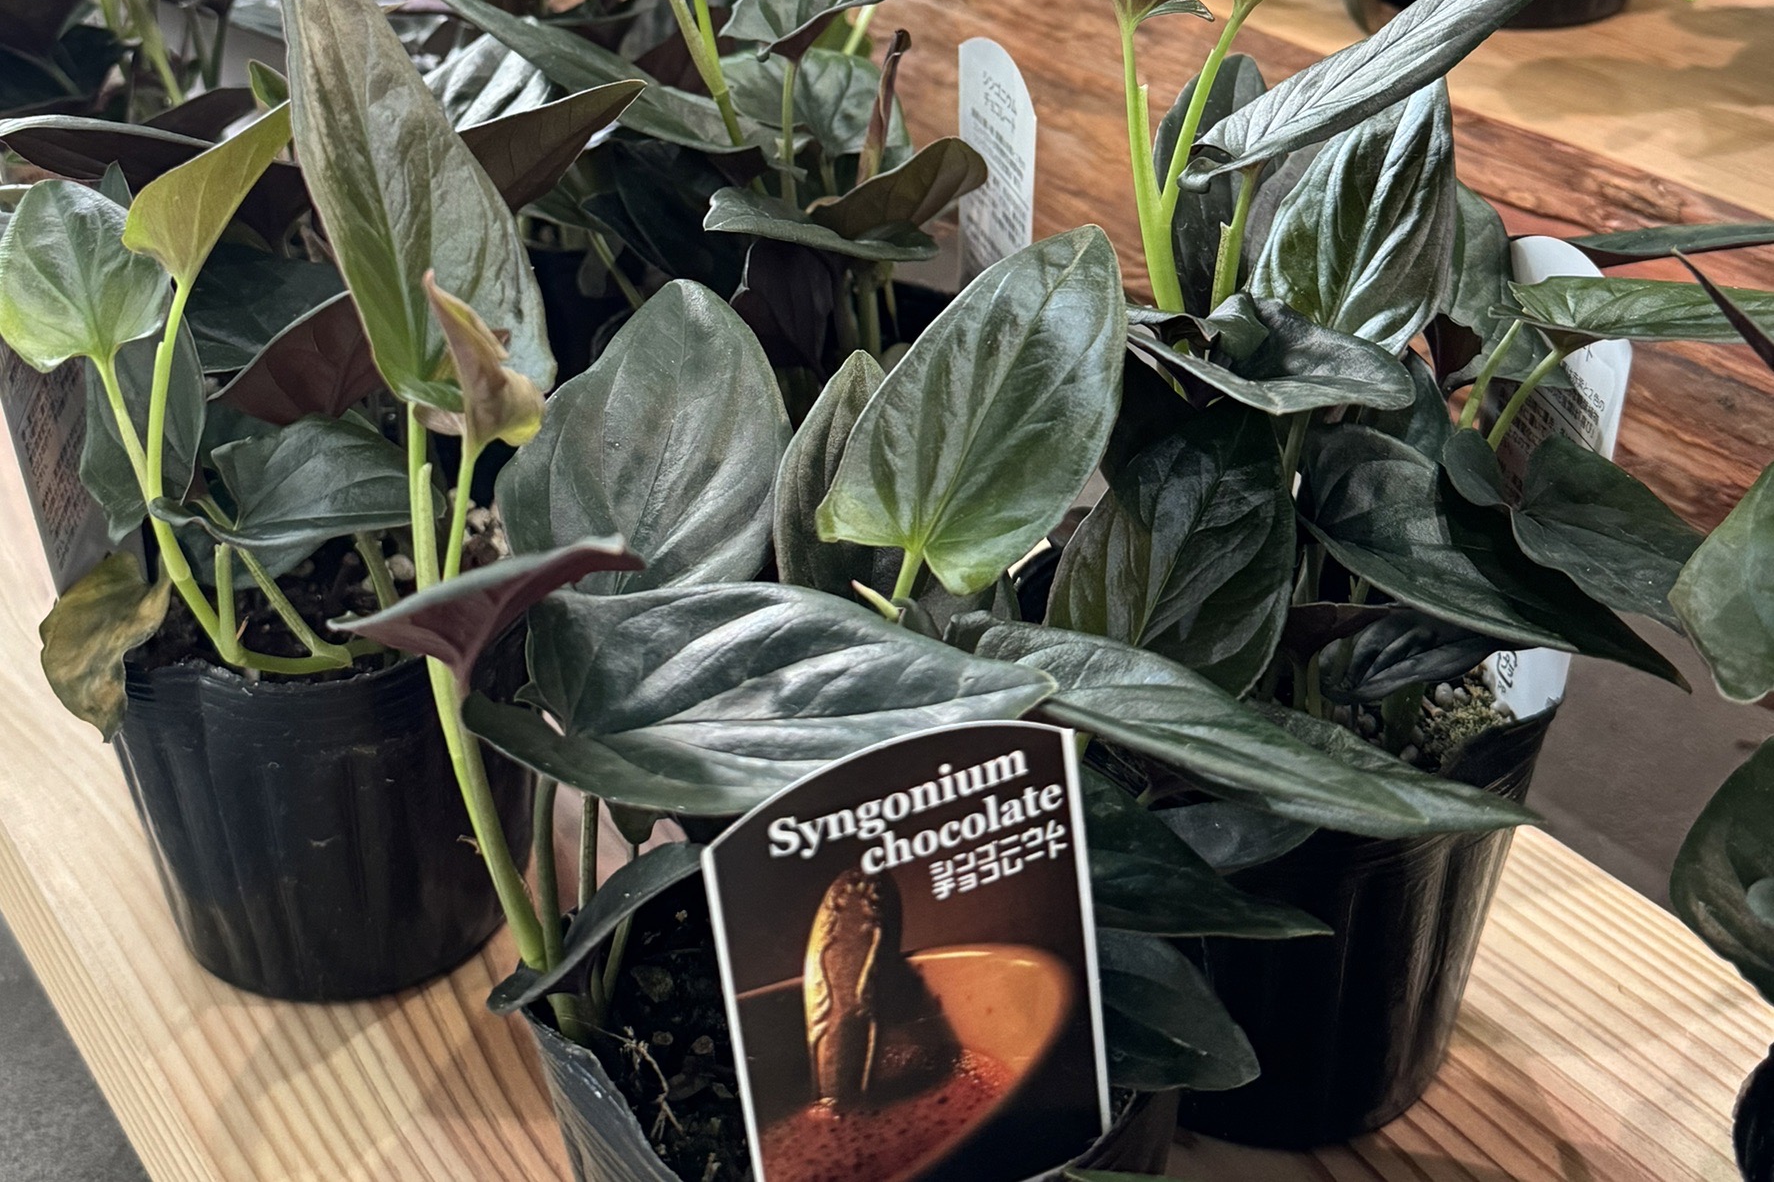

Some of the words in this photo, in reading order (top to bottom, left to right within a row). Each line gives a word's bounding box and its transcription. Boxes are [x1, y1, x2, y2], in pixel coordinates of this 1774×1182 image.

[768, 749, 1029, 859] Syngonium
[860, 783, 1064, 875] chocolate
[929, 819, 1066, 881] シンゴニウム
[931, 839, 1068, 900] チョコレート
